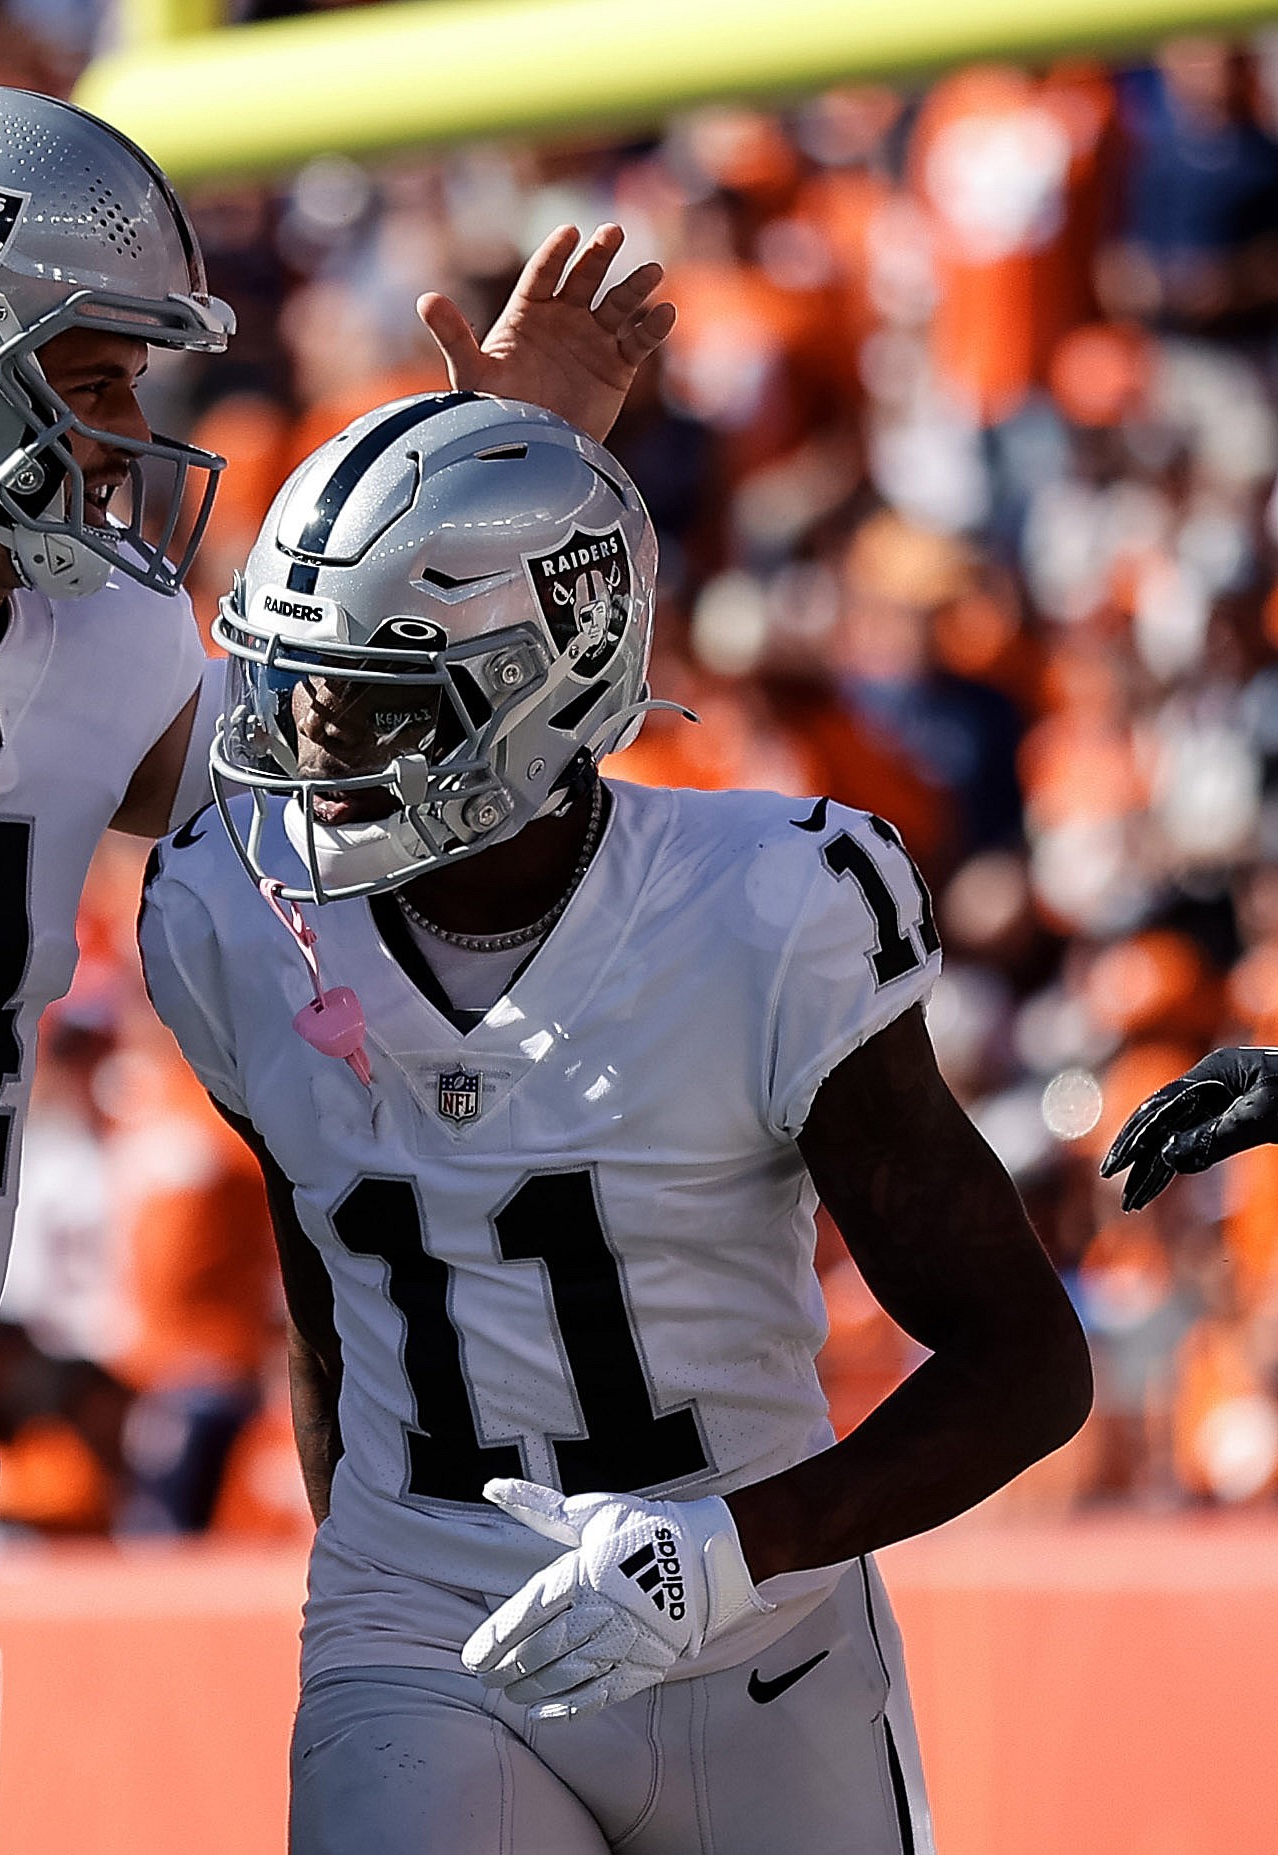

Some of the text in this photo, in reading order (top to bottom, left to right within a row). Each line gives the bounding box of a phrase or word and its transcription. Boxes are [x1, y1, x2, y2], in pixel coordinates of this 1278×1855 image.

[541, 536, 618, 577] RAIDERS
[263, 595, 324, 623] RAIDERS
[442, 1092, 476, 1117] NFL
[328, 1162, 720, 1506] 11
[654, 1527, 686, 1621] adidas
